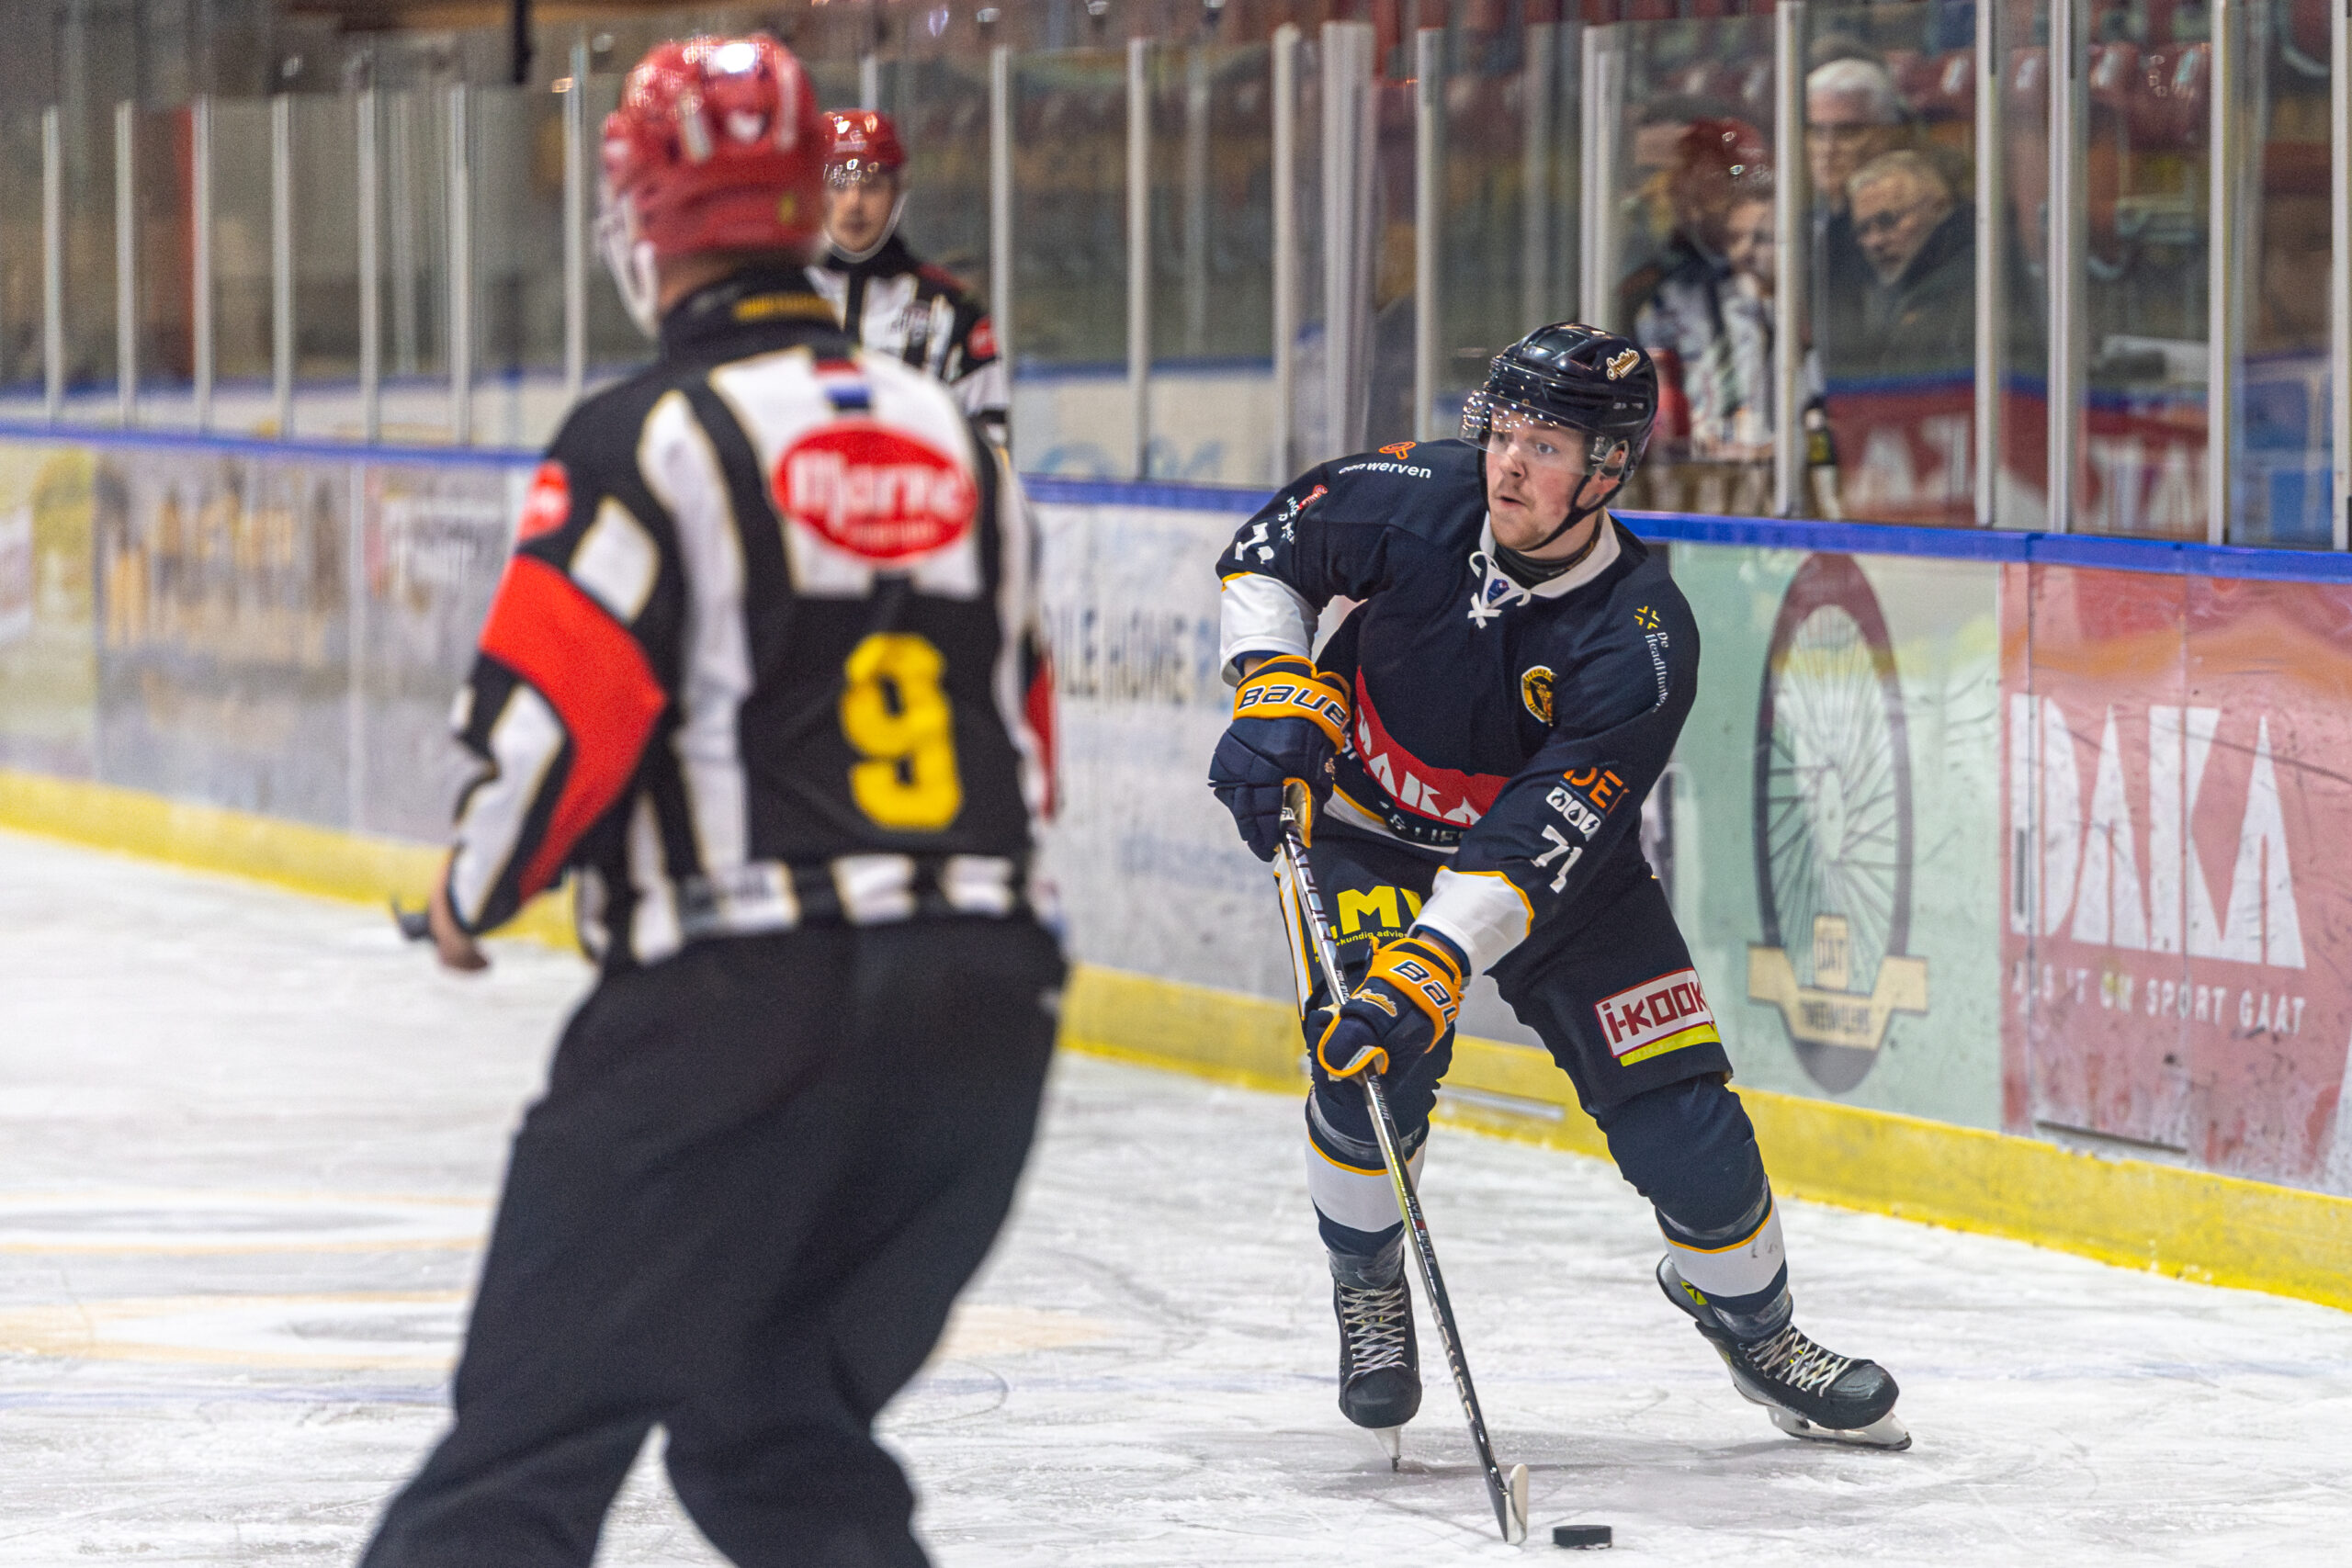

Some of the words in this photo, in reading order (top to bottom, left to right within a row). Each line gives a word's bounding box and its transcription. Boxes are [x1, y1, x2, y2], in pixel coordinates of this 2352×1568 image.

[1367, 460, 1432, 479] werven
[1657, 632, 1669, 649] De
[840, 633, 963, 831] 9
[1530, 824, 1584, 895] 71
[2009, 694, 2308, 970] DAKA
[2145, 977, 2227, 1025] SPORT
[2238, 988, 2305, 1036] GAAT
